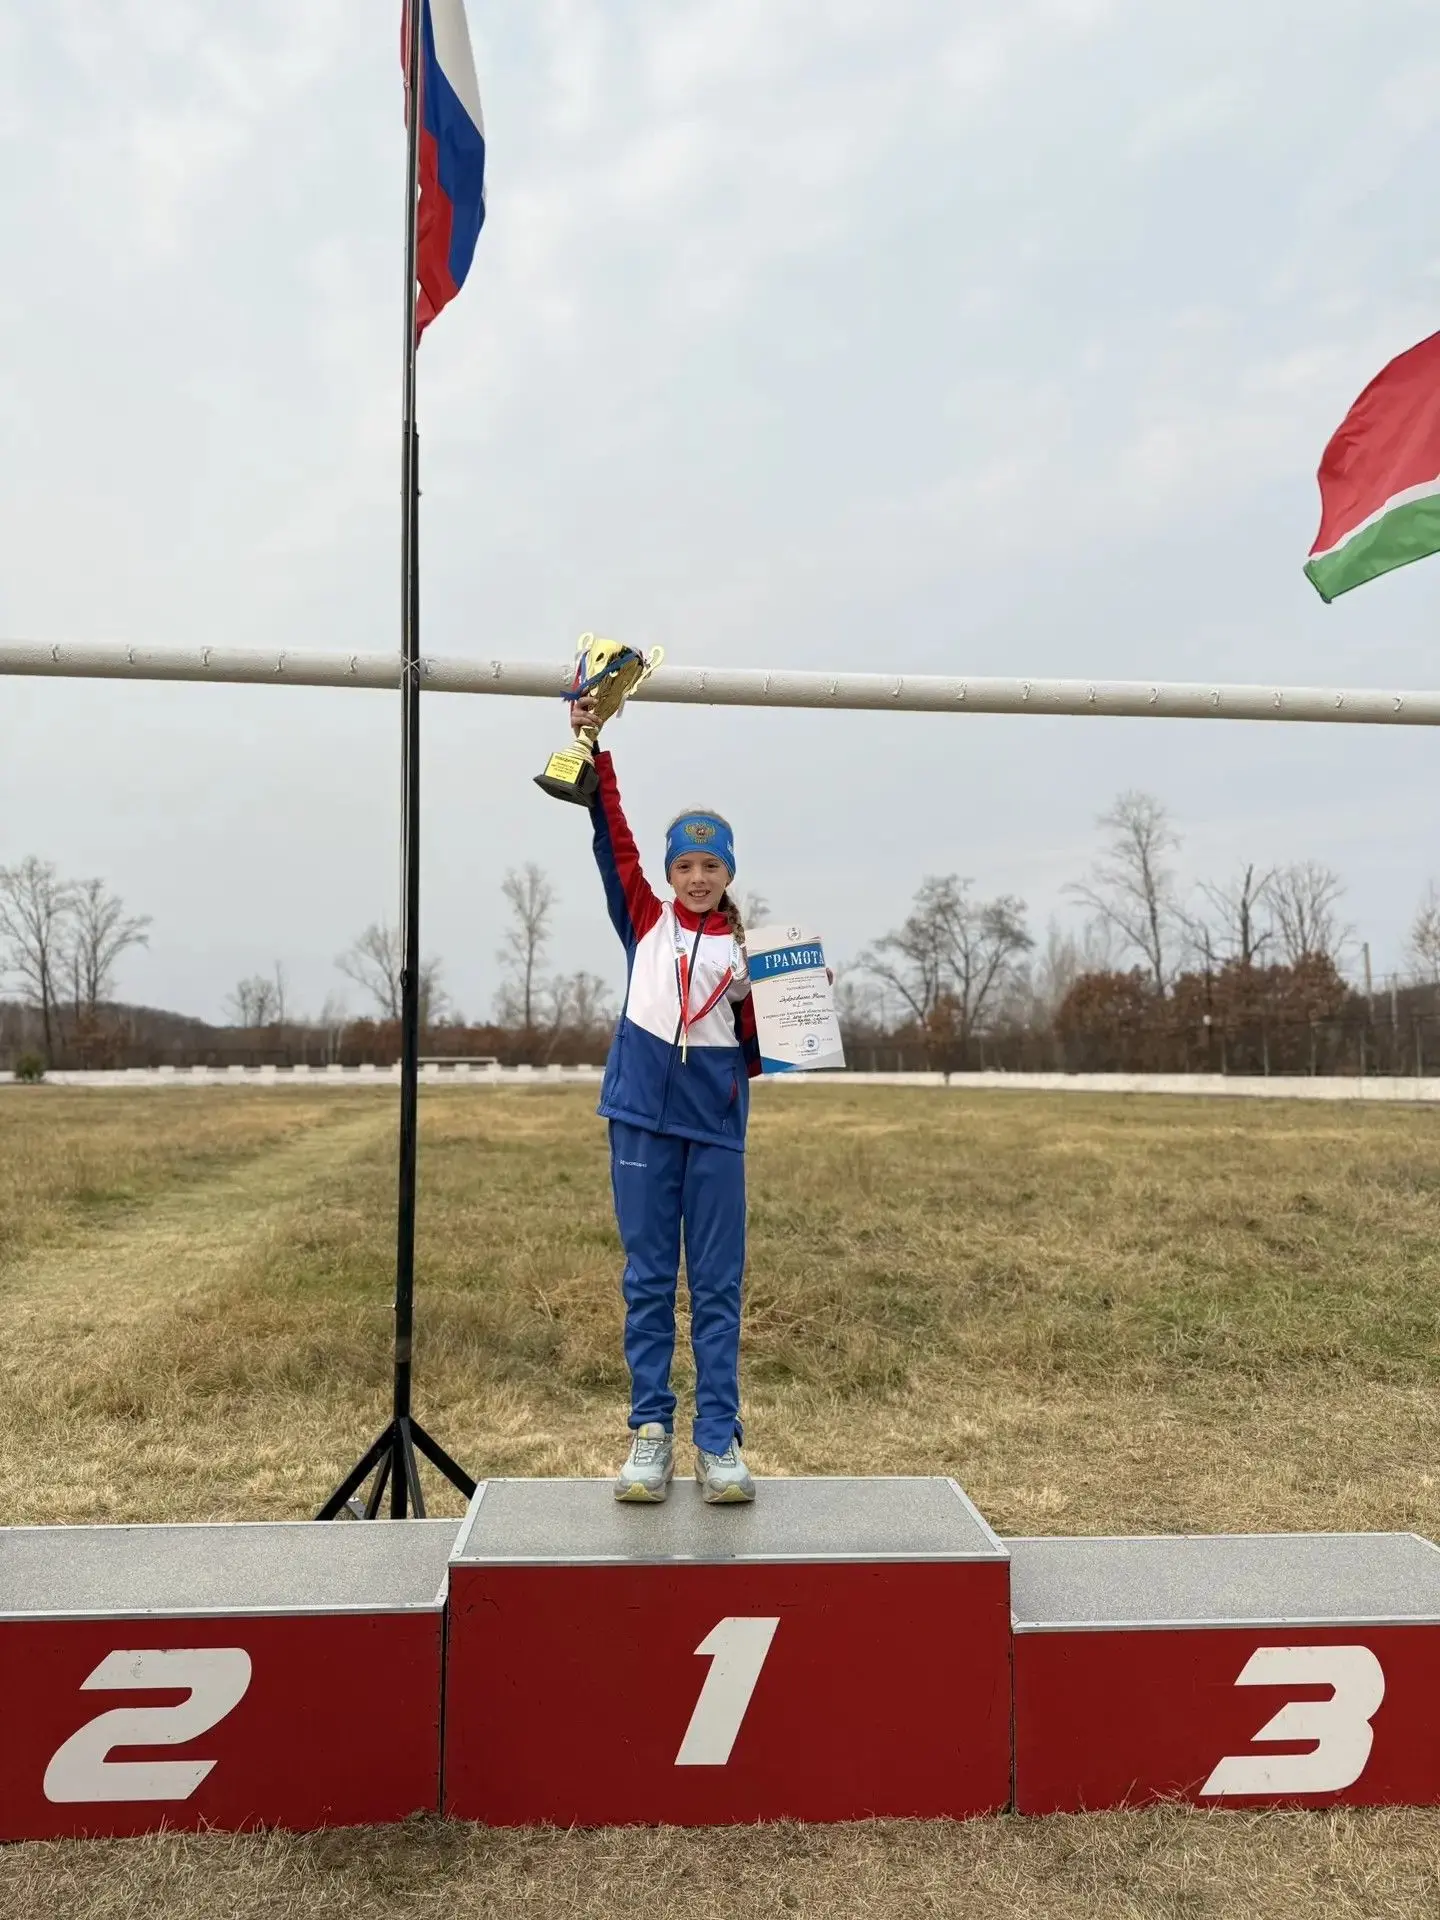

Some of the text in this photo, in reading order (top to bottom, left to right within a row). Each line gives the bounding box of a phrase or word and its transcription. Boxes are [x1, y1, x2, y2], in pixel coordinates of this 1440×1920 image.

[765, 950, 824, 969] ГРАМОТА
[44, 1648, 252, 1804] 2
[675, 1617, 780, 1766] 1
[1200, 1645, 1386, 1796] 3
